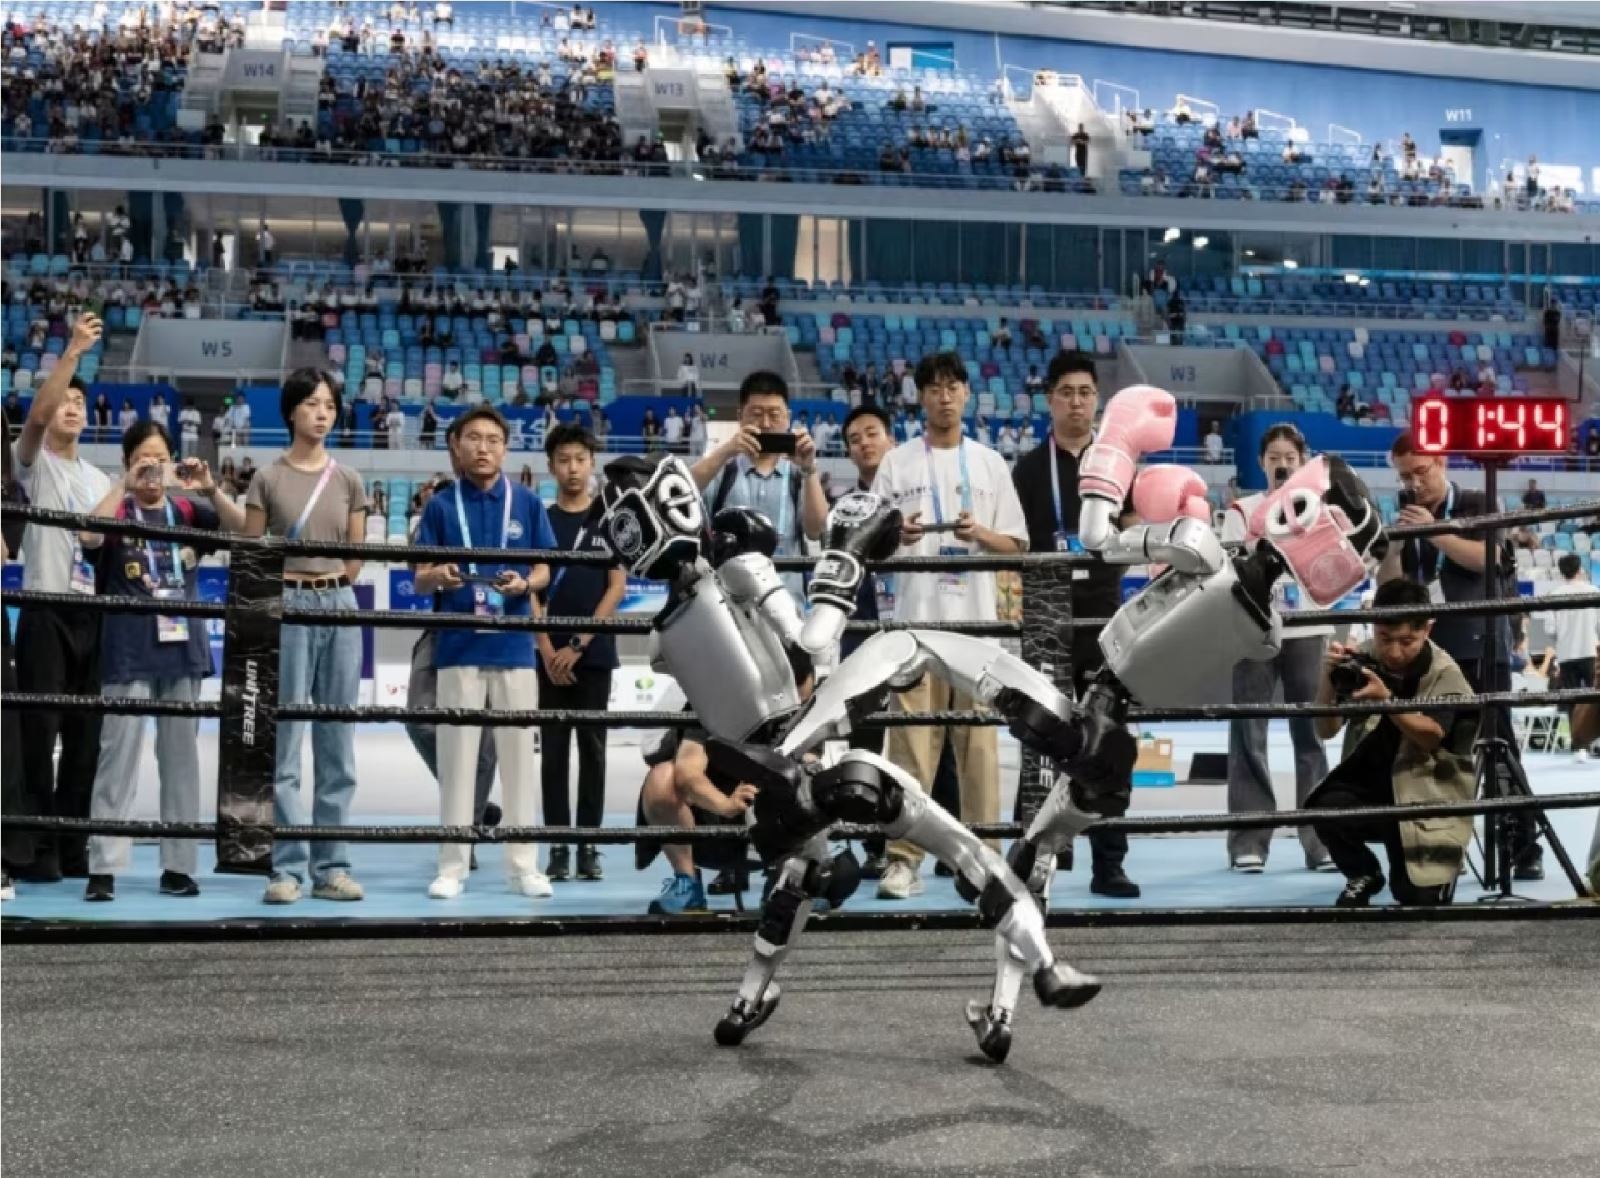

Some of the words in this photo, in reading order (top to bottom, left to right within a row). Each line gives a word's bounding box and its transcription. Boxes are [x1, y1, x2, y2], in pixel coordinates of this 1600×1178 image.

[243, 63, 274, 78] W14
[654, 81, 684, 97] W13
[1445, 108, 1472, 122] W11
[700, 351, 729, 369] W4
[1170, 364, 1196, 382] W3
[241, 659, 260, 745] UNITREE
